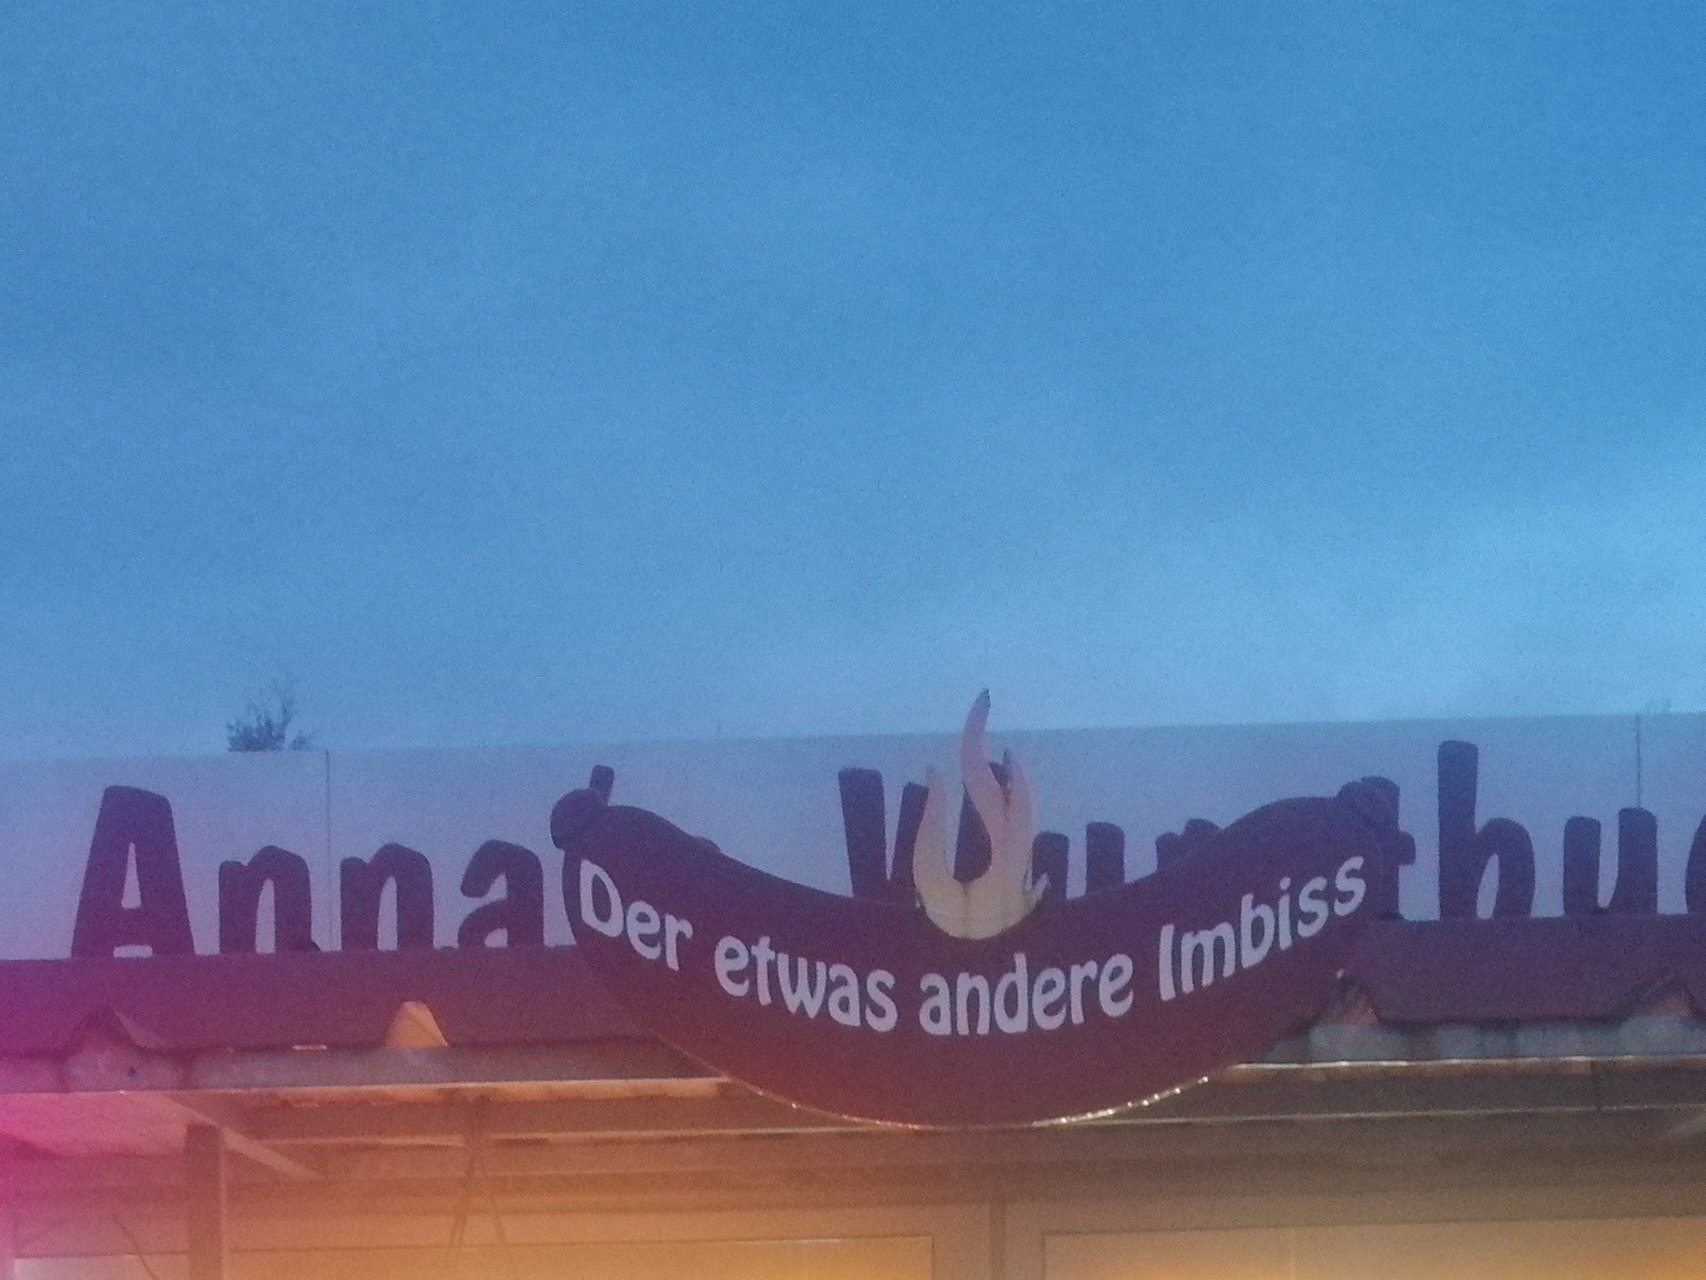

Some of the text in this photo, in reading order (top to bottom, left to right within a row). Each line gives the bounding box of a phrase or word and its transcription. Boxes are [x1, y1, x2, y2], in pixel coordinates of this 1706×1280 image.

[579, 855, 1369, 1037] Der etwas andere Imbiss
